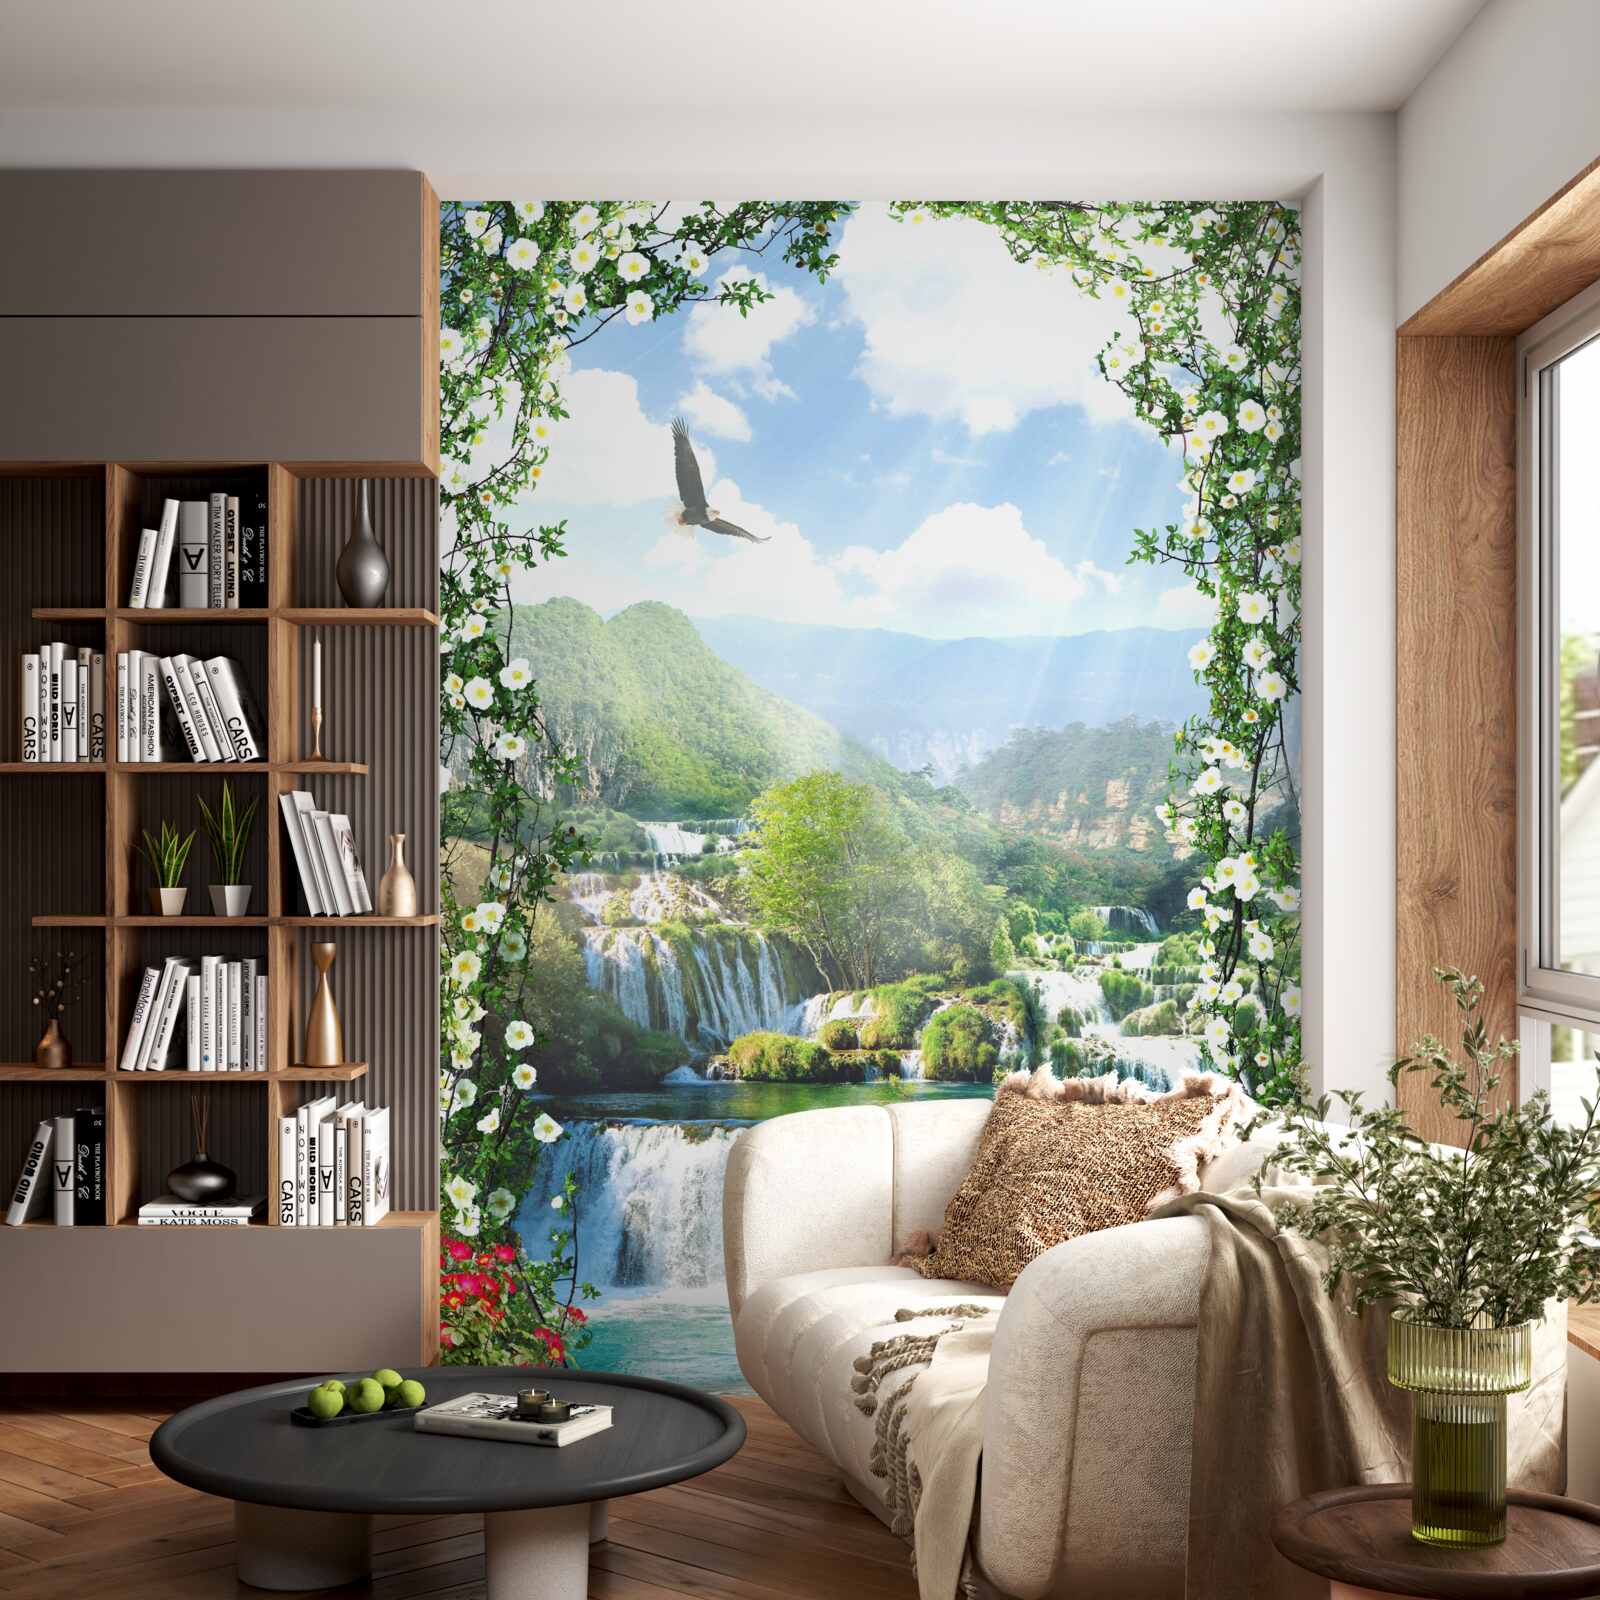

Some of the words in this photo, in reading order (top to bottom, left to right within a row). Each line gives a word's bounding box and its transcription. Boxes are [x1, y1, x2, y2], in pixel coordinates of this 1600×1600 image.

[92, 713, 104, 758] CARS
[187, 692, 197, 705] ECO
[195, 710, 208, 737] HOUSES
[24, 717, 36, 760] CARS
[182, 721, 199, 755] LIVING
[228, 717, 252, 759] CARS
[14, 1179, 31, 1204] WILD
[24, 1141, 45, 1177] WORLD
[281, 1180, 293, 1223] CARS
[350, 1177, 361, 1222] CARS
